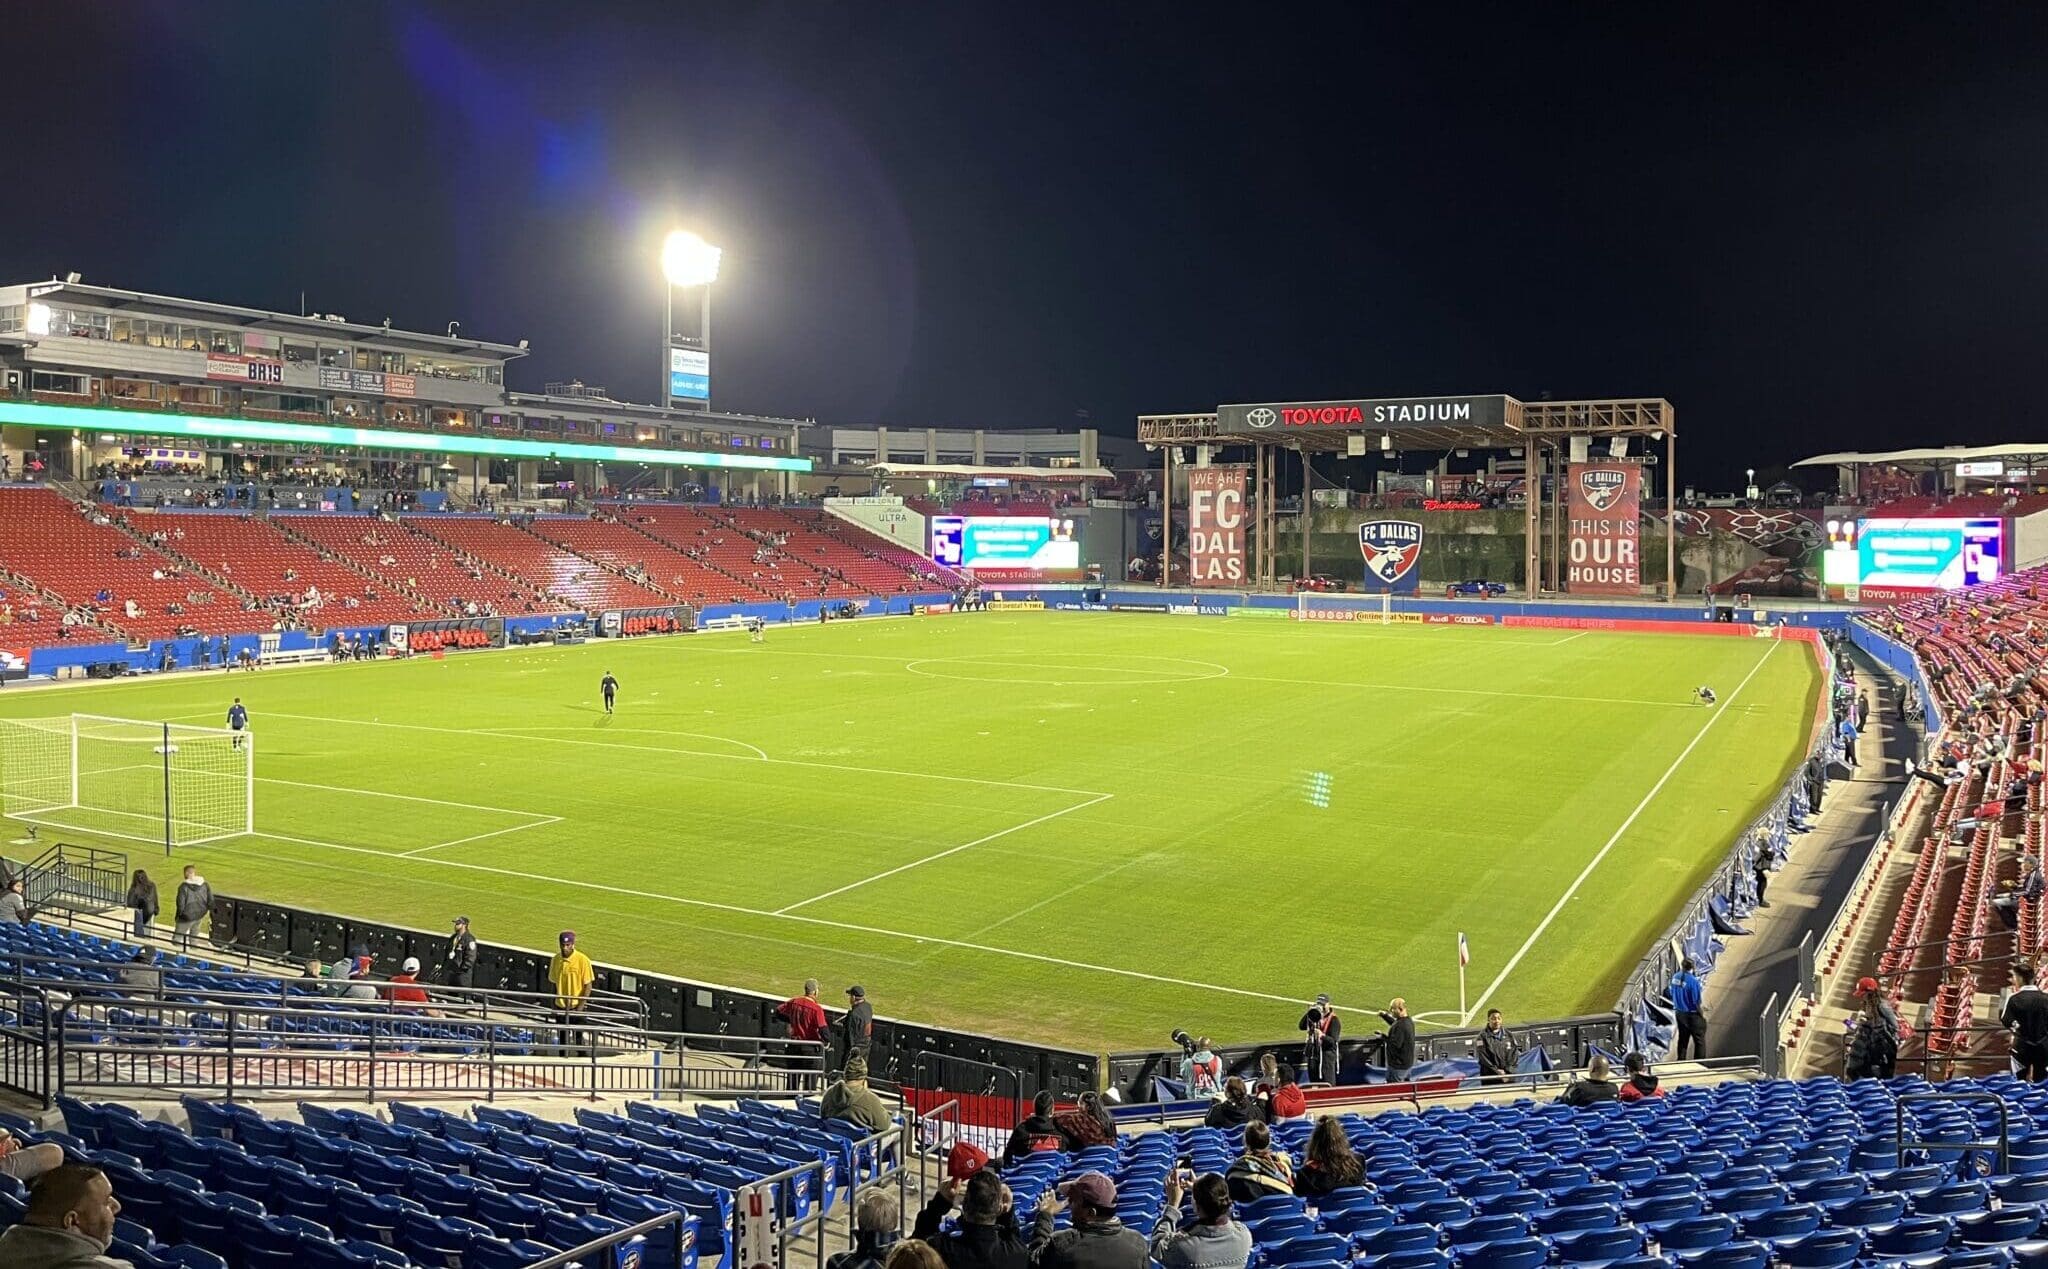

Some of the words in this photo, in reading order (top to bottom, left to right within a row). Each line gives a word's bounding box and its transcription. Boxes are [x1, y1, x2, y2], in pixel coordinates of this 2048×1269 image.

[248, 362, 281, 382] BR19
[1281, 407, 1364, 425] TOYOTA
[1374, 403, 1470, 423] STADIUM
[1194, 472, 1214, 484] WE
[1217, 472, 1241, 484] ARE
[1585, 473, 1593, 483] FC
[1595, 472, 1622, 483] DALLAS
[141, 487, 183, 497] WINNERS
[1193, 489, 1240, 529] FC
[1422, 500, 1481, 512] Budweiser
[879, 513, 907, 522] ULTRA
[1364, 526, 1376, 540] FC
[1380, 525, 1417, 540] DALLAS
[1571, 519, 1610, 535] THIS
[1619, 520, 1635, 536] IS
[1193, 532, 1241, 554] DAL
[1570, 537, 1634, 564] OUR
[1193, 557, 1242, 579] LAS
[976, 571, 1006, 579] TOYOTA
[1009, 571, 1043, 579] STADIUM
[1569, 567, 1635, 584] HOUSE
[1861, 589, 1897, 599] TOYOTA
[1200, 606, 1225, 615] BANK
[1356, 611, 1397, 621] Contineal
[1526, 617, 1615, 629] MEMBERSHIPS
